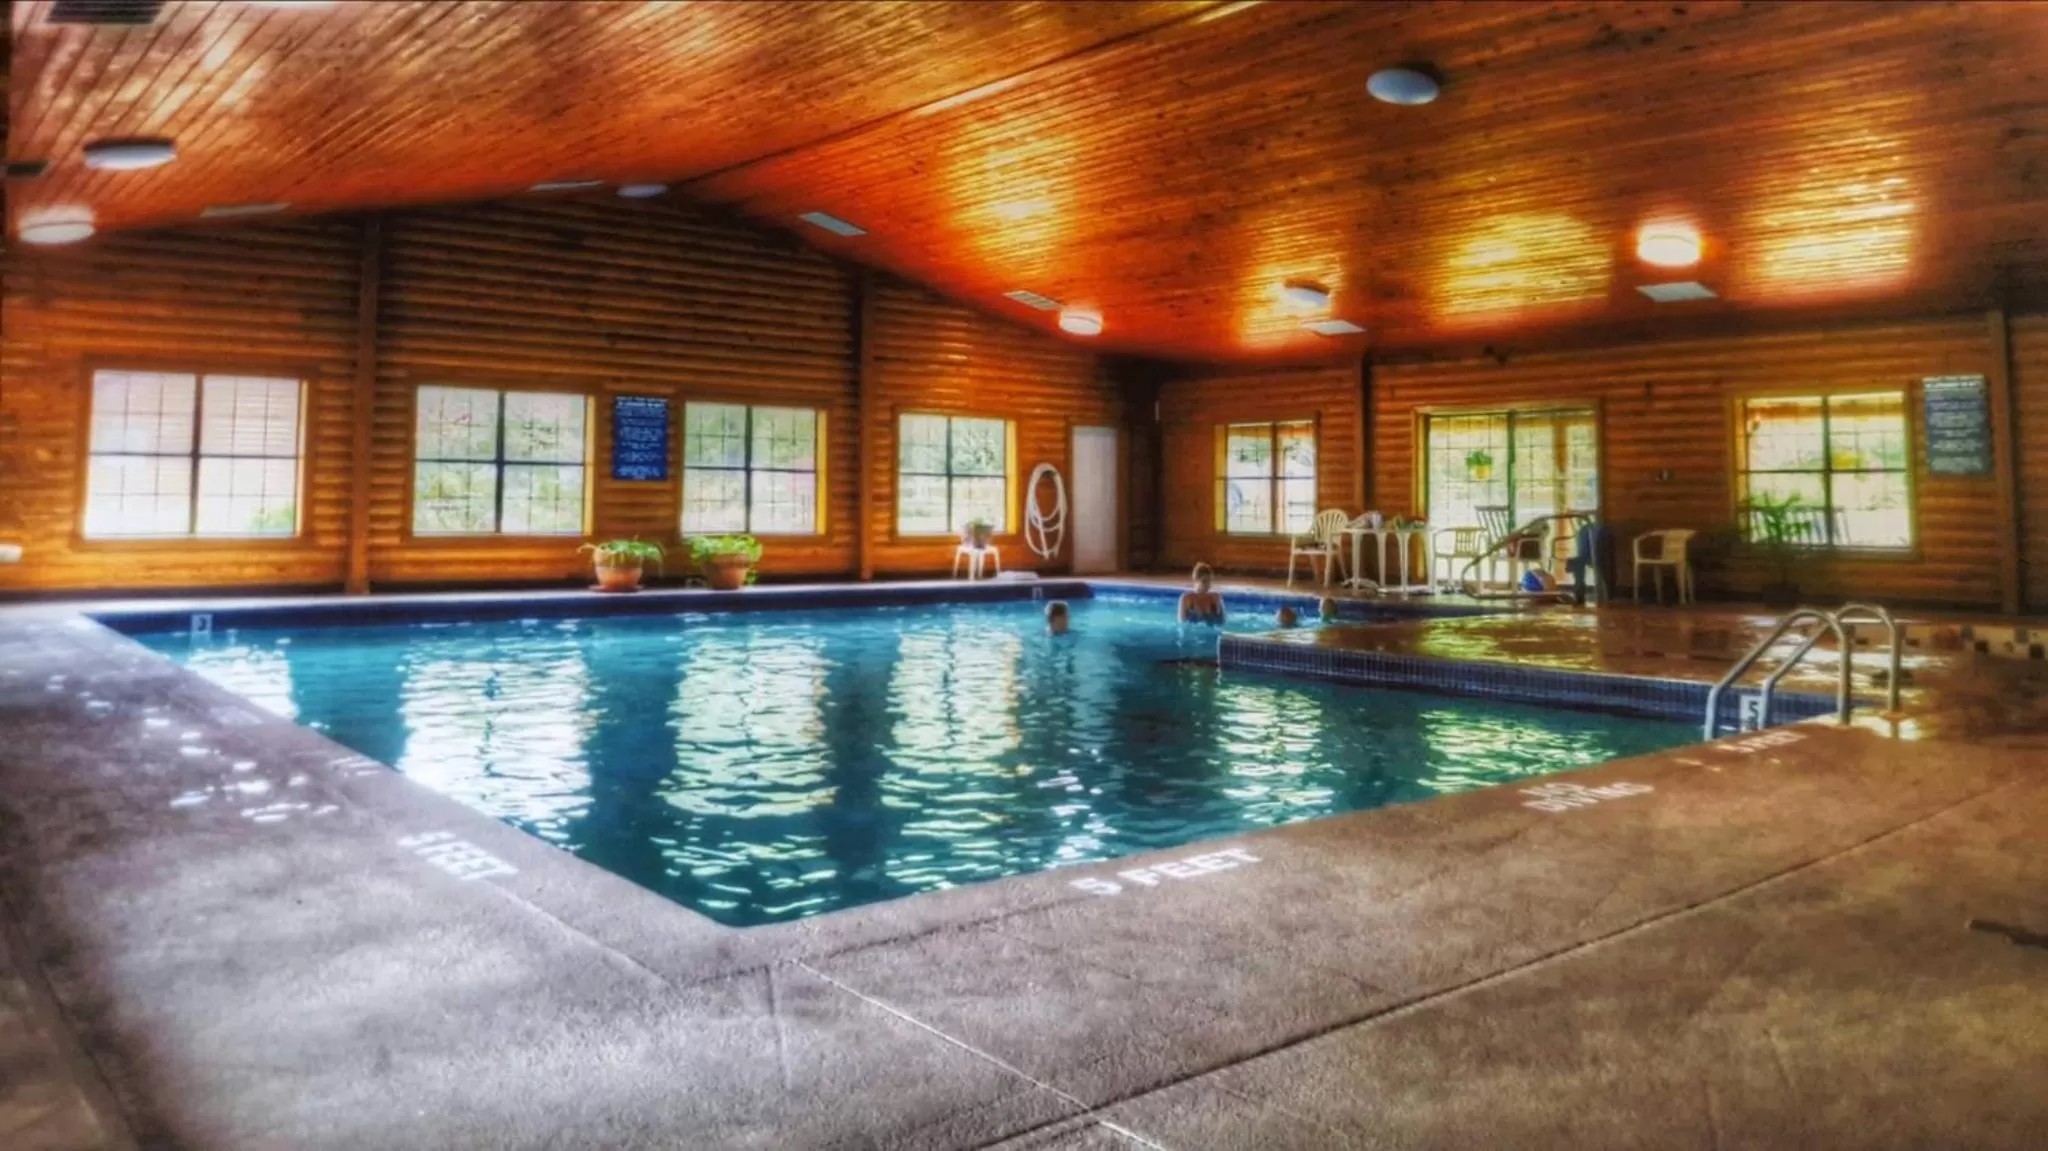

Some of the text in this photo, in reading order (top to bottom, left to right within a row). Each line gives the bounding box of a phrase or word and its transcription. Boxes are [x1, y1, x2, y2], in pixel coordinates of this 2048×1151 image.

[1748, 700, 1759, 719] 5
[1069, 848, 1263, 896] 5 FEET
